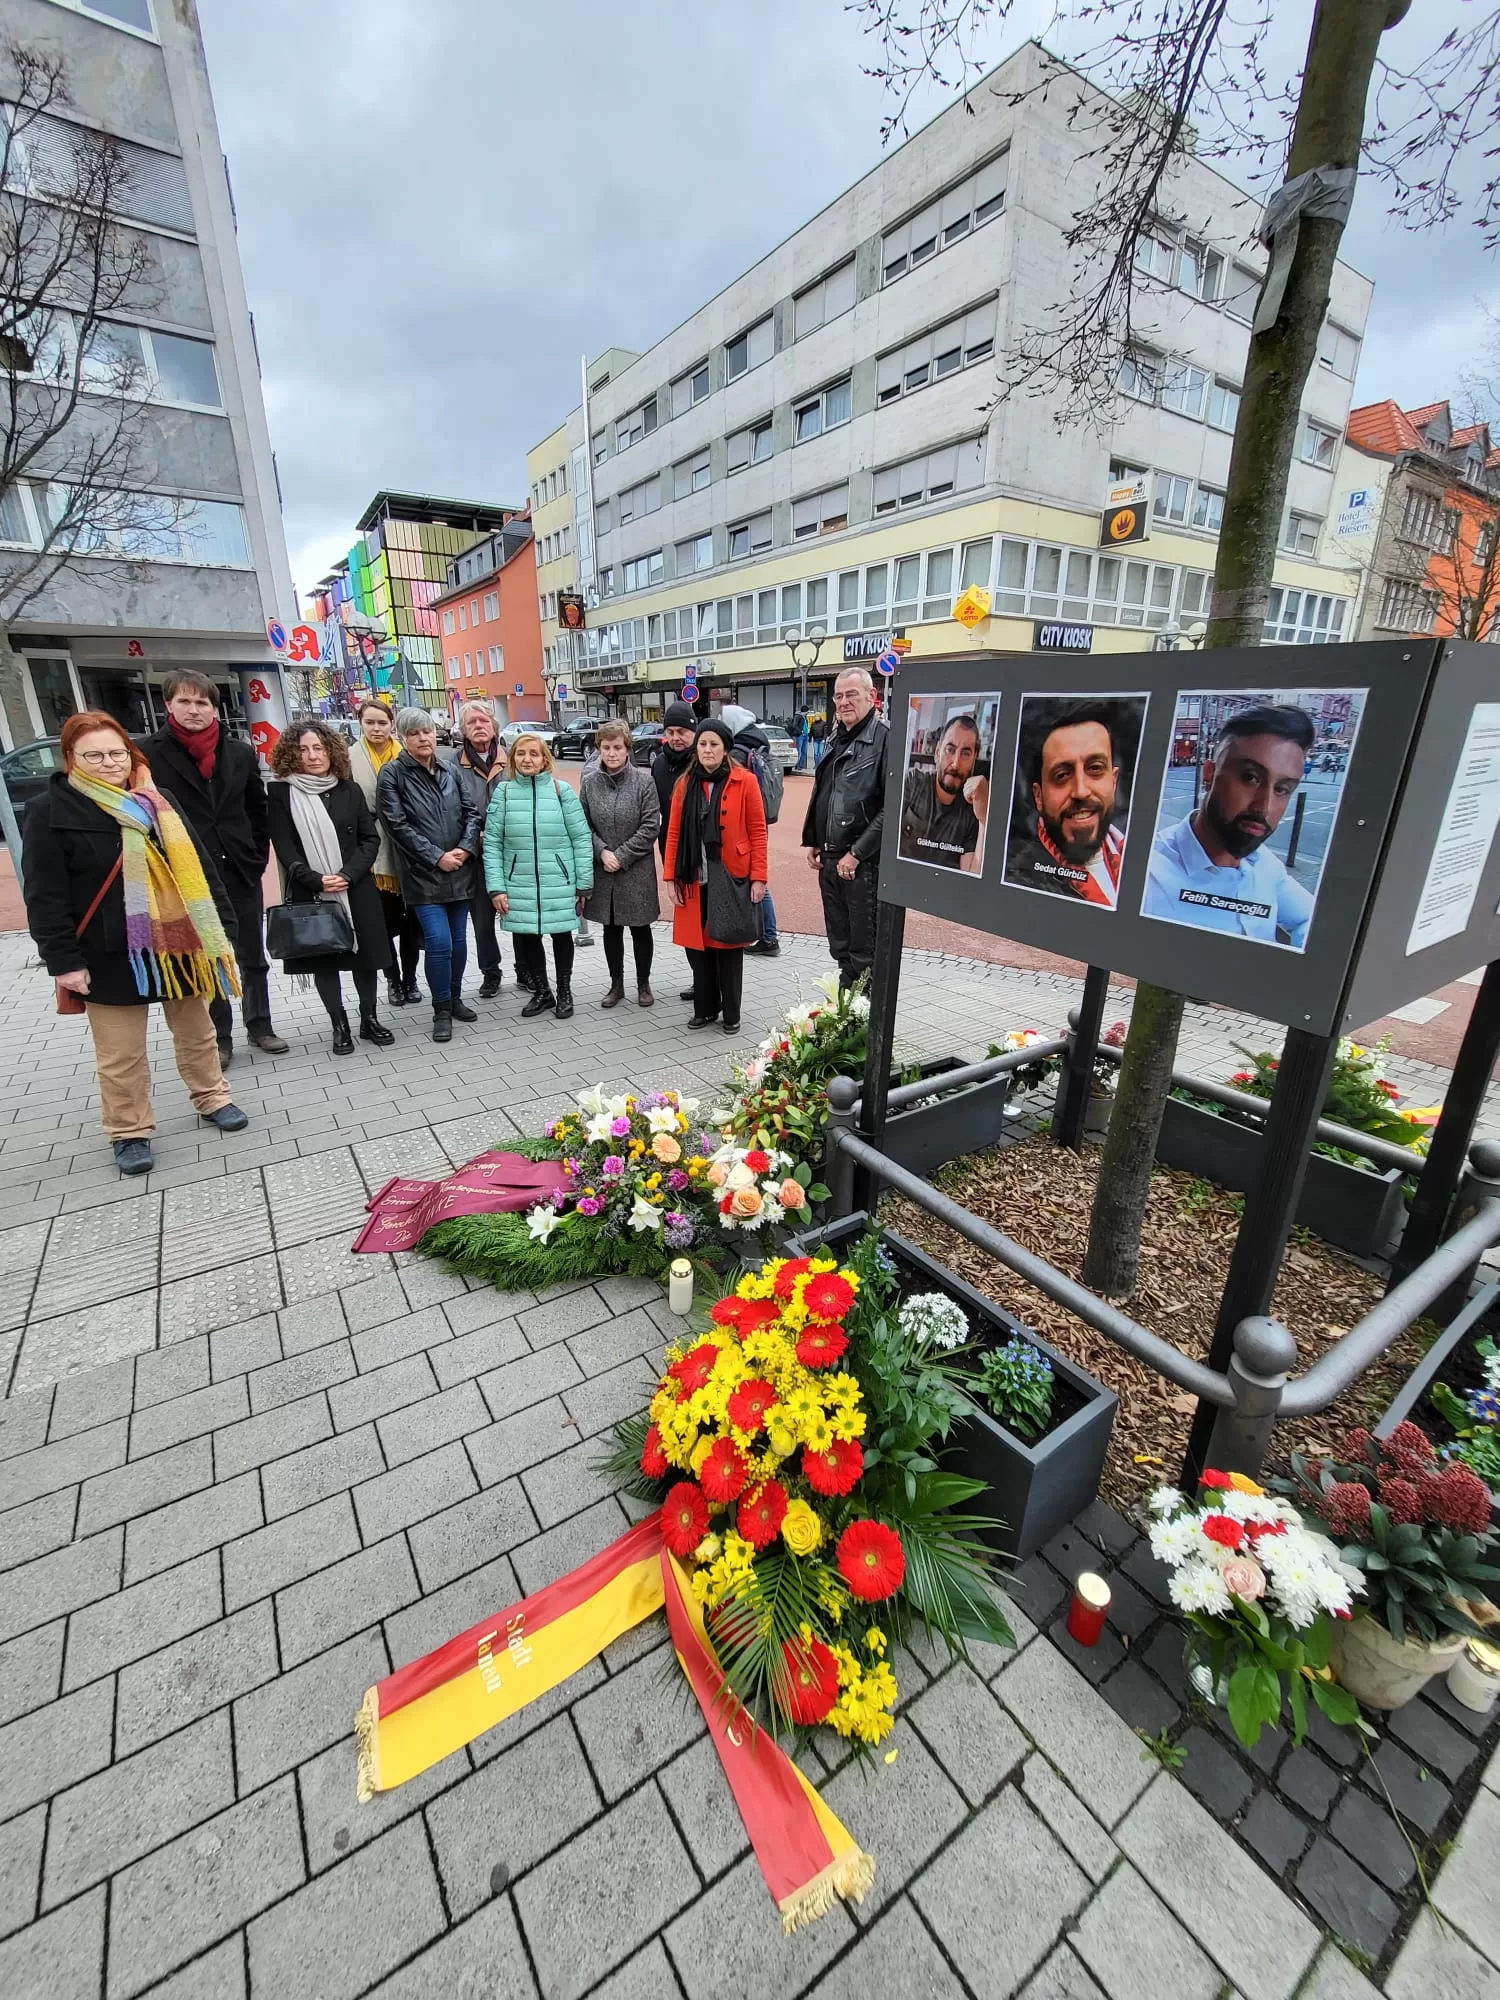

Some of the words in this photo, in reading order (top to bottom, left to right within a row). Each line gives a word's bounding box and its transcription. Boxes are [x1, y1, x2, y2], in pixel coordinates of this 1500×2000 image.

[845, 637, 866, 657] CITY
[1040, 625, 1064, 647] CITY
[1063, 627, 1092, 649] KIOSK
[917, 837, 939, 849] Gökhan
[1034, 862, 1057, 874] Sedat
[1057, 867, 1088, 881] Gürbüz
[1181, 890, 1209, 905] Fatih
[1210, 896, 1269, 916] Saraçoğlu
